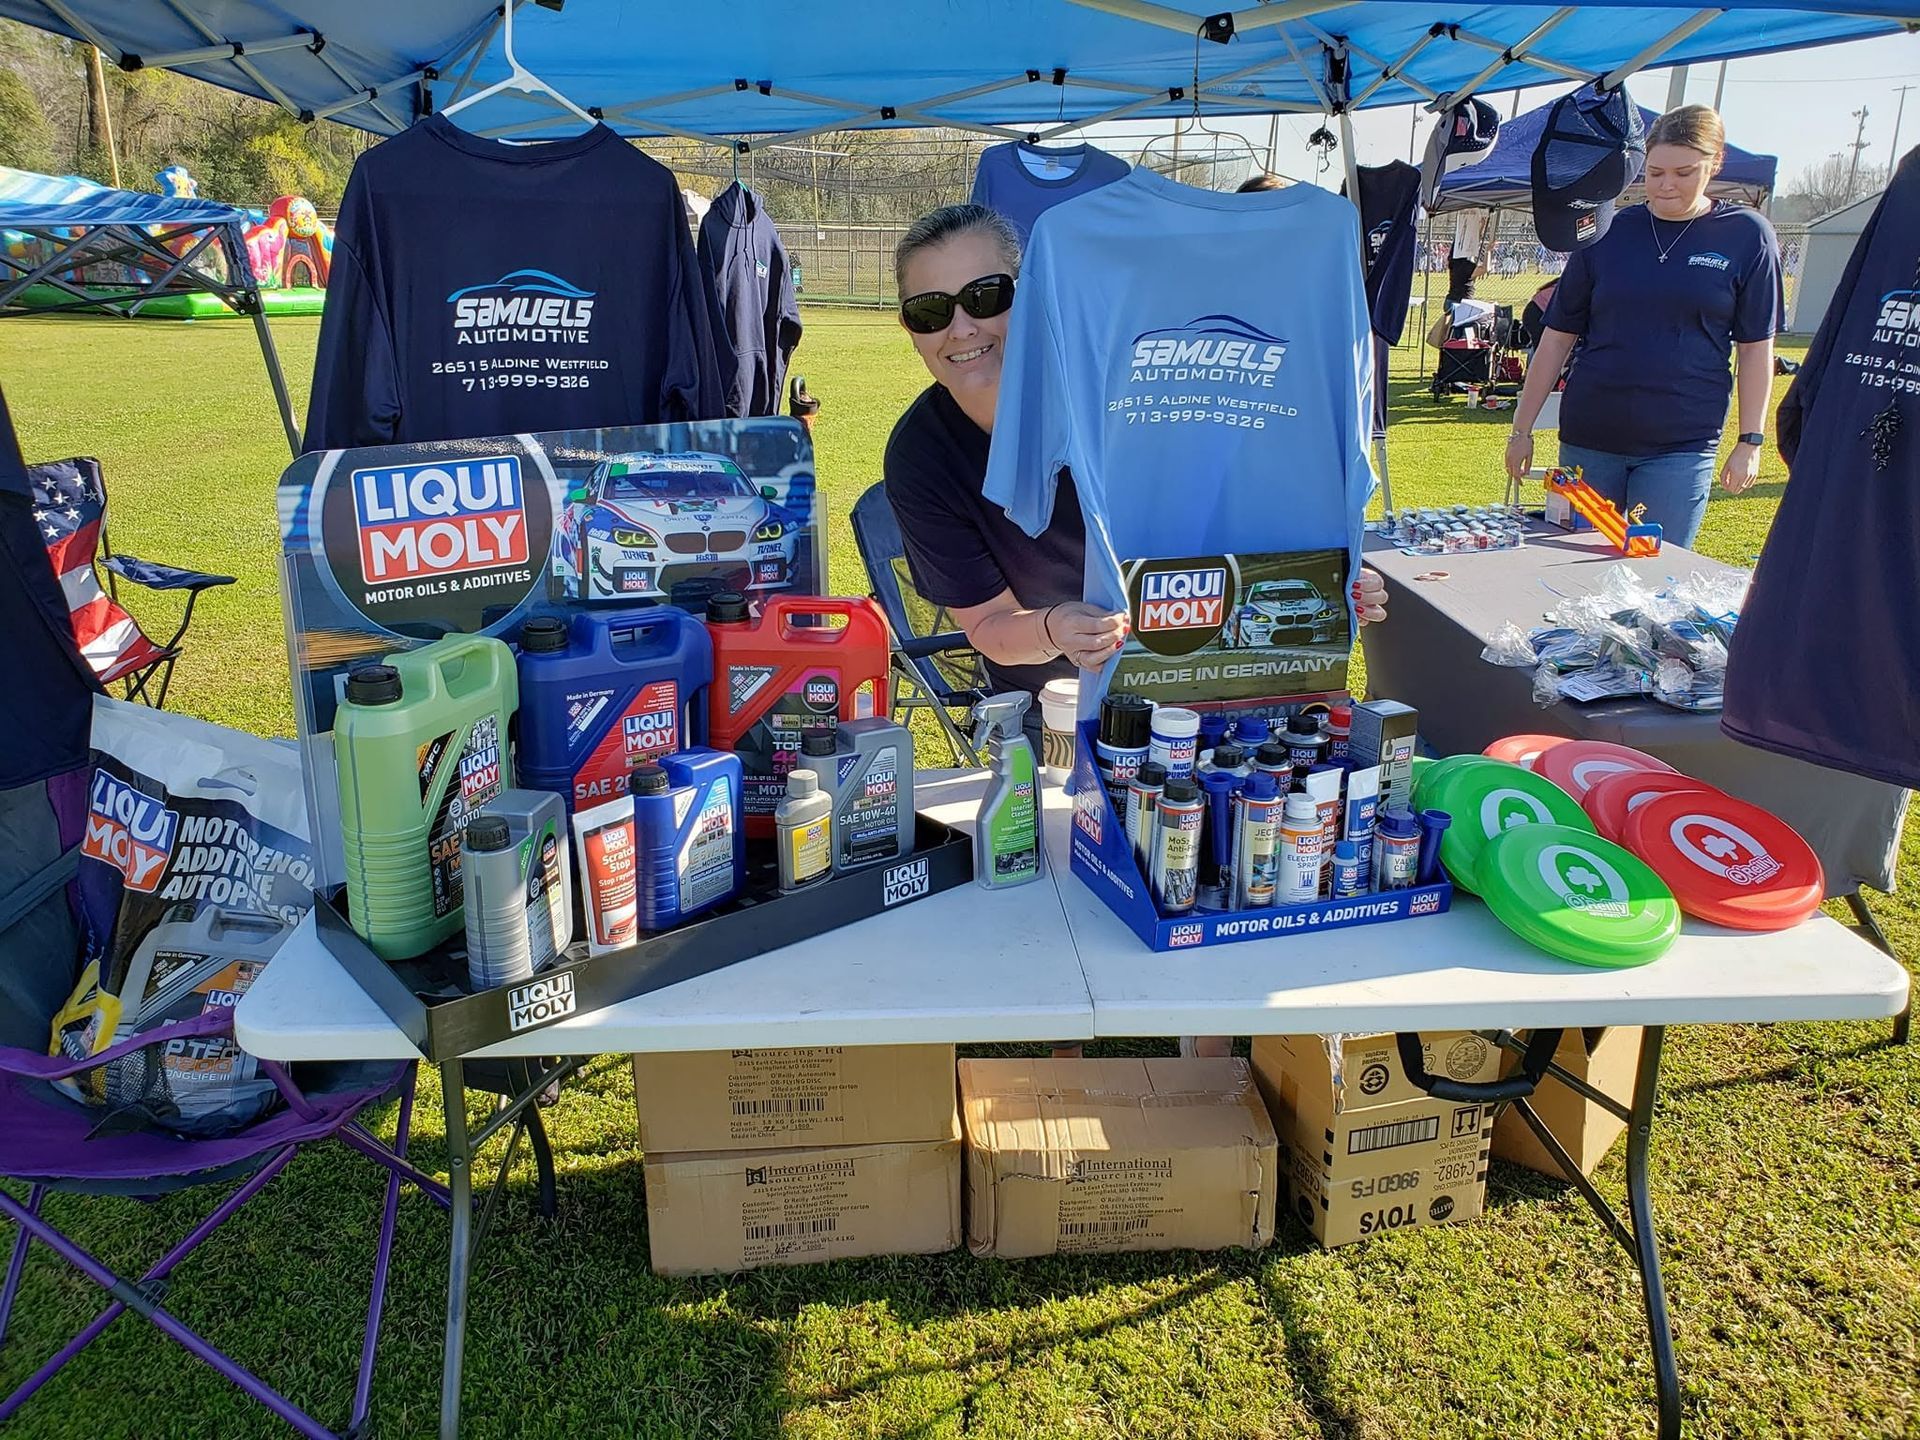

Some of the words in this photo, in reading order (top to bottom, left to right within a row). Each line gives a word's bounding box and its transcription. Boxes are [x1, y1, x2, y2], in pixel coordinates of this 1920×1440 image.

[457, 328, 589, 345] AUTOMOTIVE
[432, 360, 489, 373] 26515
[491, 358, 540, 370] ALDINE
[545, 358, 609, 370] WESTFIELD
[1845, 353, 1883, 368] 26515
[462, 374, 590, 391] 713-999-9326
[1130, 368, 1276, 387] AUTOMOTIVE
[1108, 395, 1153, 411] 26515
[1159, 395, 1211, 405] ALDINE
[1217, 396, 1297, 417] WESTFIELD
[1126, 410, 1265, 429] 713-999-9326
[363, 462, 514, 522] LIQUI
[370, 514, 521, 577] MOLY
[757, 543, 782, 554] TURNER
[624, 571, 647, 581] LIQUI
[760, 564, 778, 572] LIQUI
[760, 572, 778, 580] MOLY
[365, 586, 414, 605] MOTOR
[417, 581, 447, 596] OILS
[450, 580, 460, 592] &
[463, 570, 531, 589] ADDITIVES
[623, 580, 648, 589] MOLY
[1146, 572, 1221, 600] LIQUI
[1144, 598, 1220, 628] MOLY
[1124, 667, 1192, 687] MADE
[1196, 666, 1218, 680] IN
[1222, 656, 1336, 679] GERMANY
[589, 689, 615, 698] Germany
[808, 684, 834, 693] LIQUI
[808, 693, 835, 702] MOLY
[625, 712, 672, 734] LIQUI
[627, 729, 673, 751] MOLY
[462, 747, 496, 775] LIQUI
[1291, 757, 1315, 766] MOLY
[1292, 749, 1316, 758] LIQUI
[463, 764, 498, 796] MOLY
[866, 772, 894, 785] LIQUI
[576, 777, 612, 800] SAE
[866, 783, 894, 796] MOLY
[1015, 789, 1031, 797] MOLY
[92, 775, 171, 849] LIQUI
[702, 804, 728, 820] LIQUI
[1076, 790, 1101, 823] LIQUI
[702, 815, 729, 832] MOLY
[839, 814, 859, 825] SAE
[861, 806, 896, 820] 10W-40
[864, 818, 885, 829] MOTOR
[1077, 809, 1101, 841] MOLY
[604, 829, 626, 843] LIQUI
[431, 833, 460, 865] SAE
[602, 846, 635, 865] Scratch
[610, 859, 631, 873] Stop
[702, 855, 720, 868] MOTOR
[1297, 861, 1318, 869] SPRAY
[1724, 853, 1781, 885] O'Reilly
[599, 877, 615, 887] Stop
[886, 861, 926, 887] LIQUI
[887, 877, 926, 900] MOLY
[1412, 893, 1439, 904] LIQUI
[1564, 892, 1630, 917] O'Reilly
[1411, 902, 1438, 914] MOLY
[1216, 919, 1270, 937] MOTOR
[1272, 914, 1305, 930] OILS
[1308, 912, 1320, 925] &
[1322, 901, 1399, 923] ADDITIVES
[1171, 924, 1203, 935] LIQUI
[1170, 934, 1202, 946] MOLY
[179, 952, 203, 961] Germany
[511, 974, 571, 1009] LIQUI
[514, 993, 571, 1027] MOLY
[728, 1080, 768, 1088] Description:
[769, 1158, 854, 1176] International
[1087, 1157, 1172, 1171] International
[838, 1169, 855, 1177] ltd
[1154, 1169, 1173, 1179] ltd
[1351, 1177, 1375, 1199] FS
[1377, 1170, 1420, 1194] 99GD
[1429, 1199, 1455, 1216] MATTEL
[1359, 1203, 1416, 1235] TOYS
